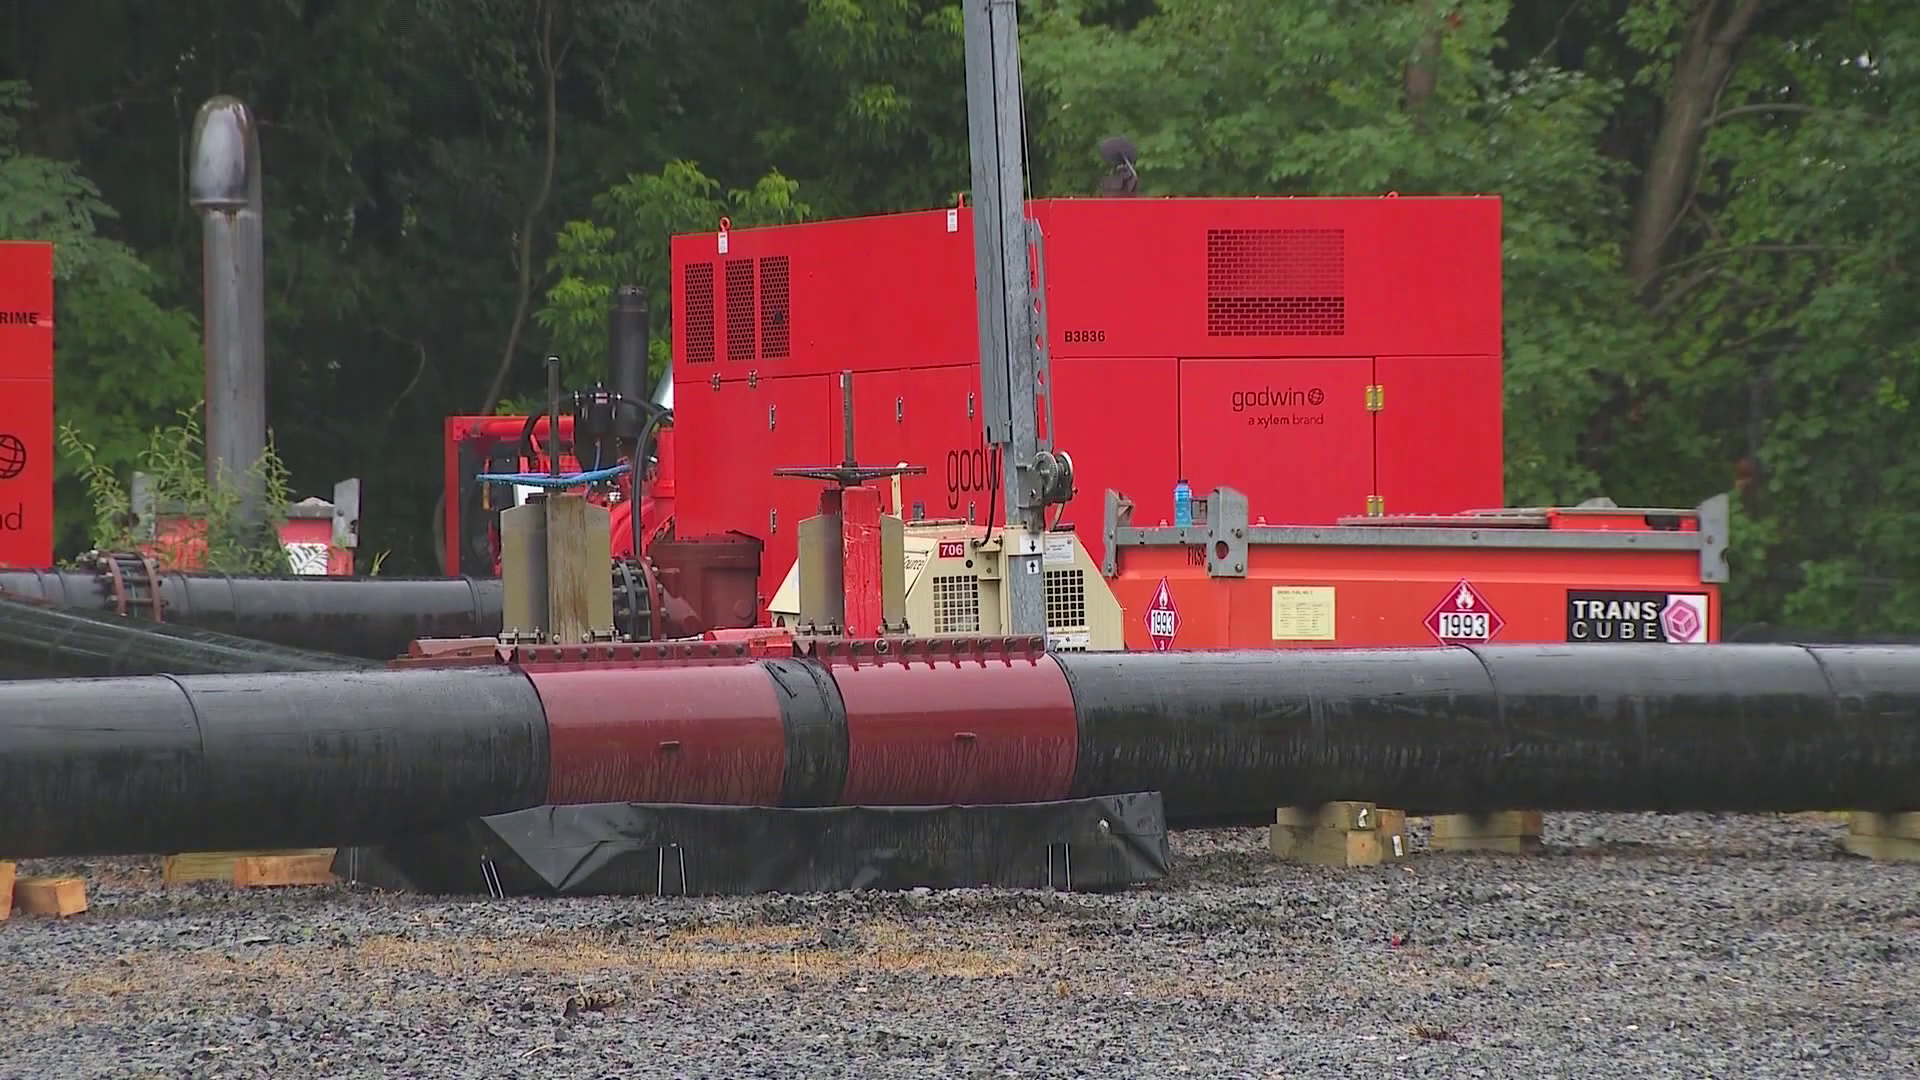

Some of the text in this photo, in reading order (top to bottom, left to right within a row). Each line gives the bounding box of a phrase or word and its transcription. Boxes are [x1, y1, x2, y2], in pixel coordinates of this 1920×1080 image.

[0, 311, 38, 324] RIME
[1064, 330, 1105, 343] B3836
[1232, 385, 1305, 412] godwin
[1248, 413, 1324, 429] a xylem brand
[940, 544, 964, 556] 706
[1572, 600, 1658, 620] TRANS
[1152, 611, 1173, 635] 1993
[1442, 614, 1486, 637] 1993
[1572, 621, 1658, 639] CUBE
